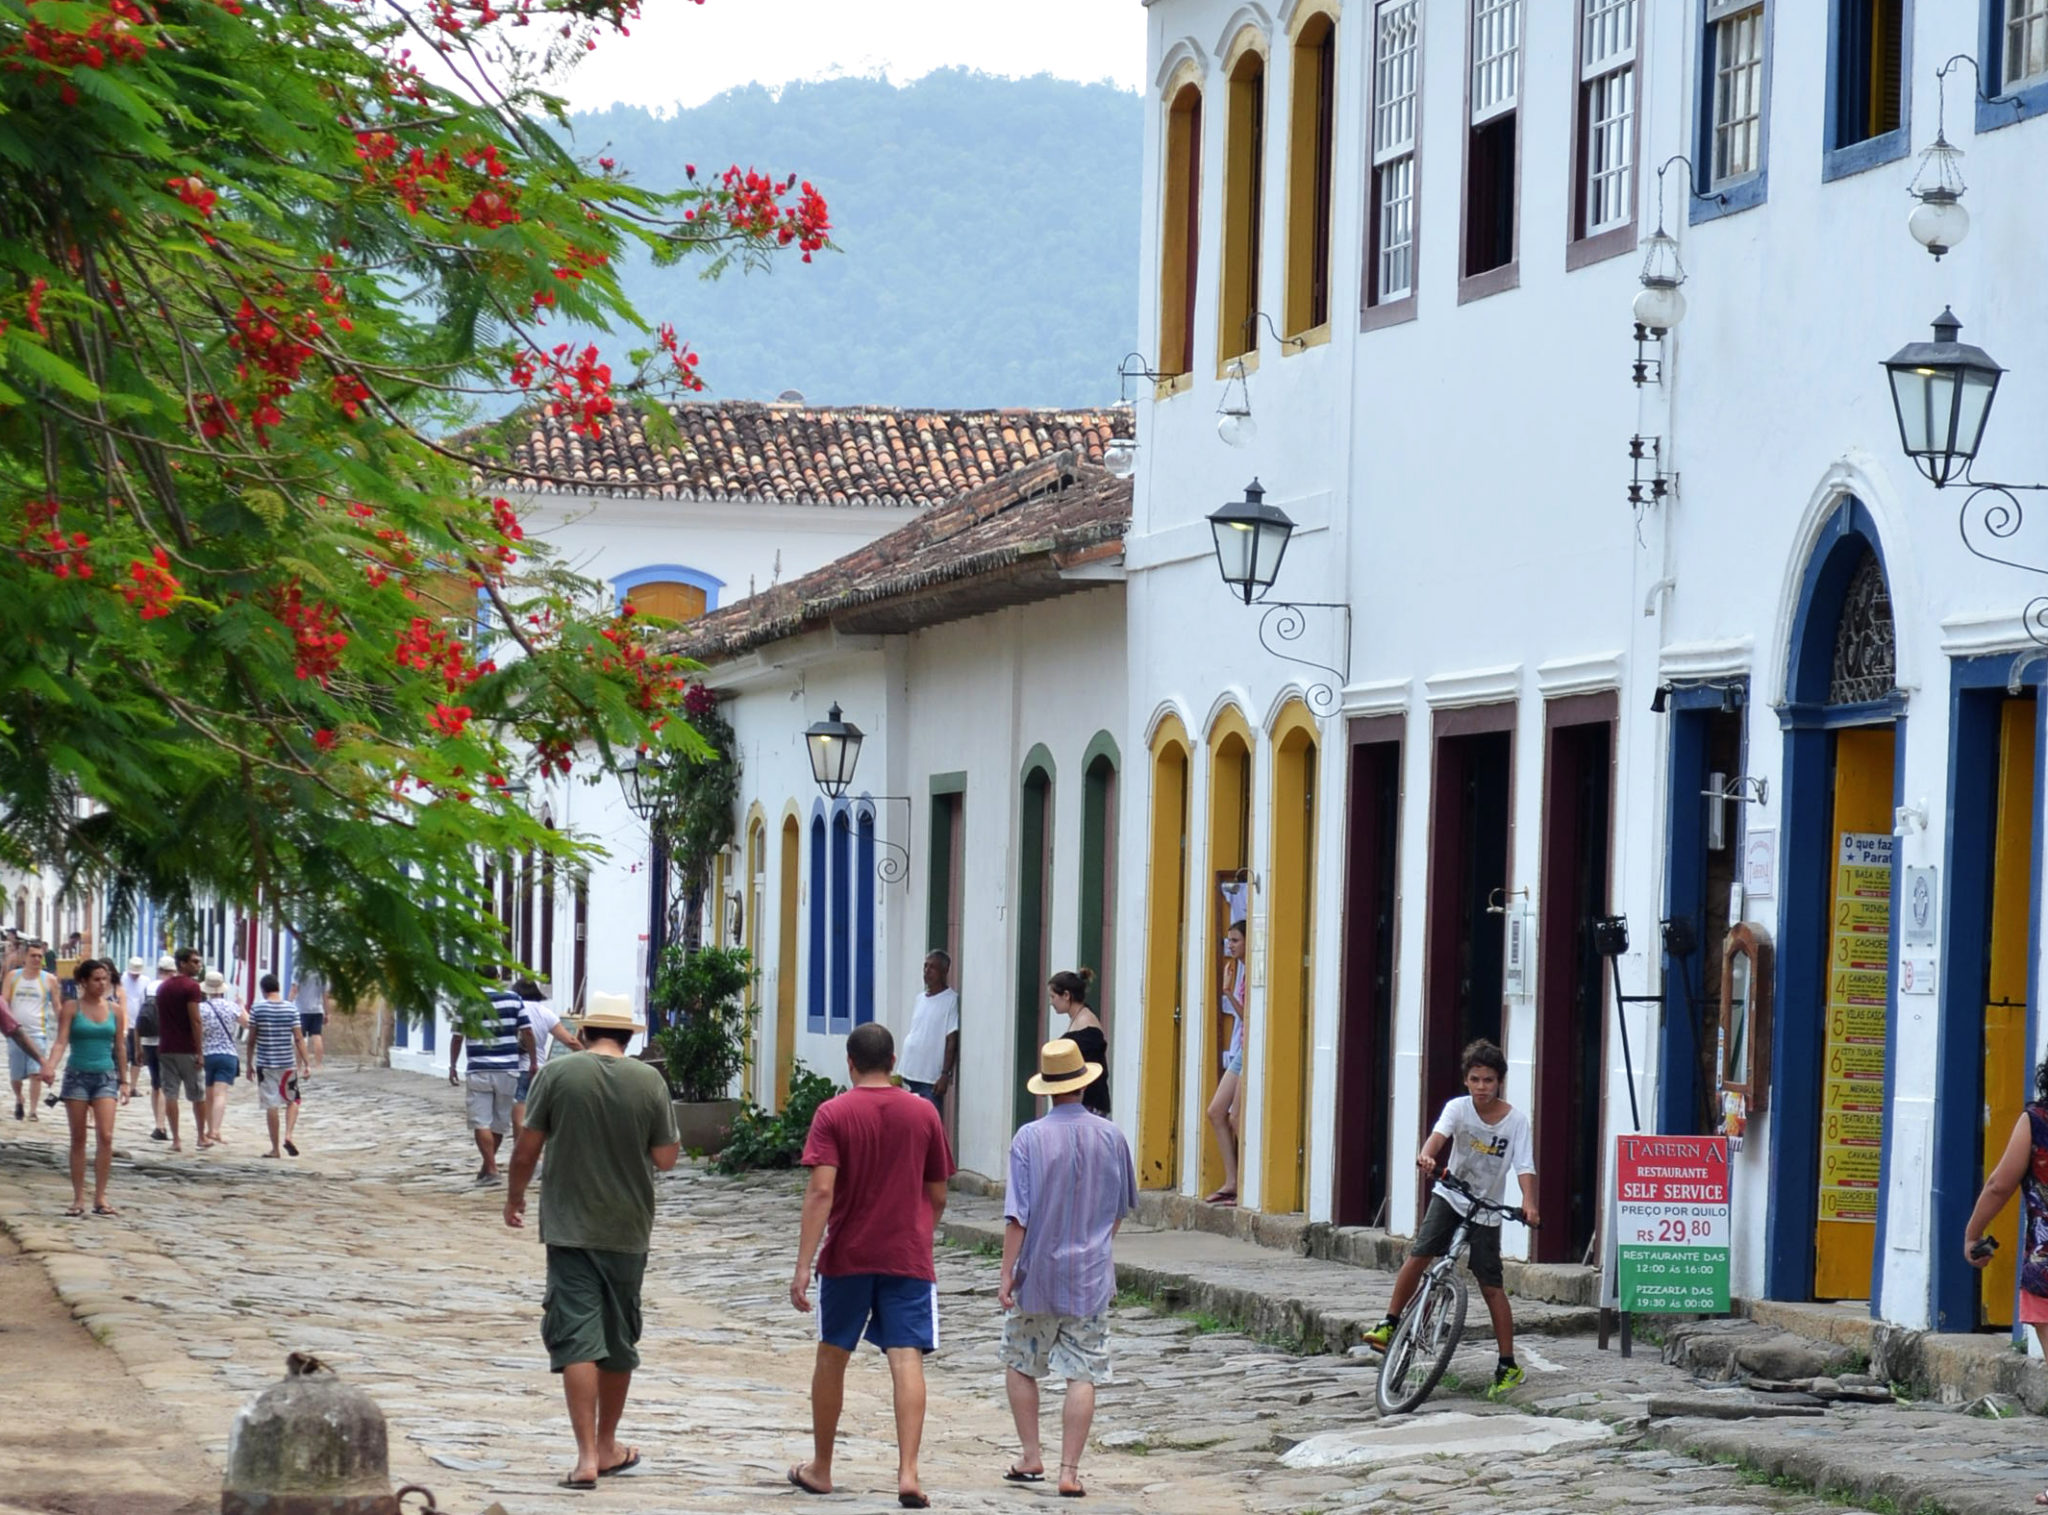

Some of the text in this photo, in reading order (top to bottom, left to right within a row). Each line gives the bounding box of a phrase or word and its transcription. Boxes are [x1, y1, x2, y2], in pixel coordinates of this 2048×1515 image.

[1845, 836, 1853, 848] O
[1856, 840, 1875, 851] que
[1839, 903, 1850, 926] 2
[1838, 938, 1849, 961] 3
[1836, 974, 1846, 998] 4
[1833, 1010, 1844, 1036] 5
[1831, 1049, 1842, 1073] 6
[1831, 1085, 1841, 1106] 7
[1828, 1115, 1838, 1139] 8
[1637, 1166, 1709, 1179] RESTAURANTE
[1827, 1155, 1837, 1176] 9
[1624, 1183, 1723, 1200] SELF SERVICE
[1621, 1205, 1727, 1217] PREÇO POR QUILO
[1821, 1194, 1837, 1211] 10
[1637, 1230, 1655, 1242] R$
[1623, 1251, 1726, 1262] RESTAURANTE DAS
[1636, 1264, 1666, 1273] 12:00
[1685, 1265, 1714, 1274] 16:00
[1636, 1285, 1714, 1296] PIZZARIA DAS
[1637, 1298, 1666, 1307] 19:30
[1684, 1299, 1714, 1308] 00:00
